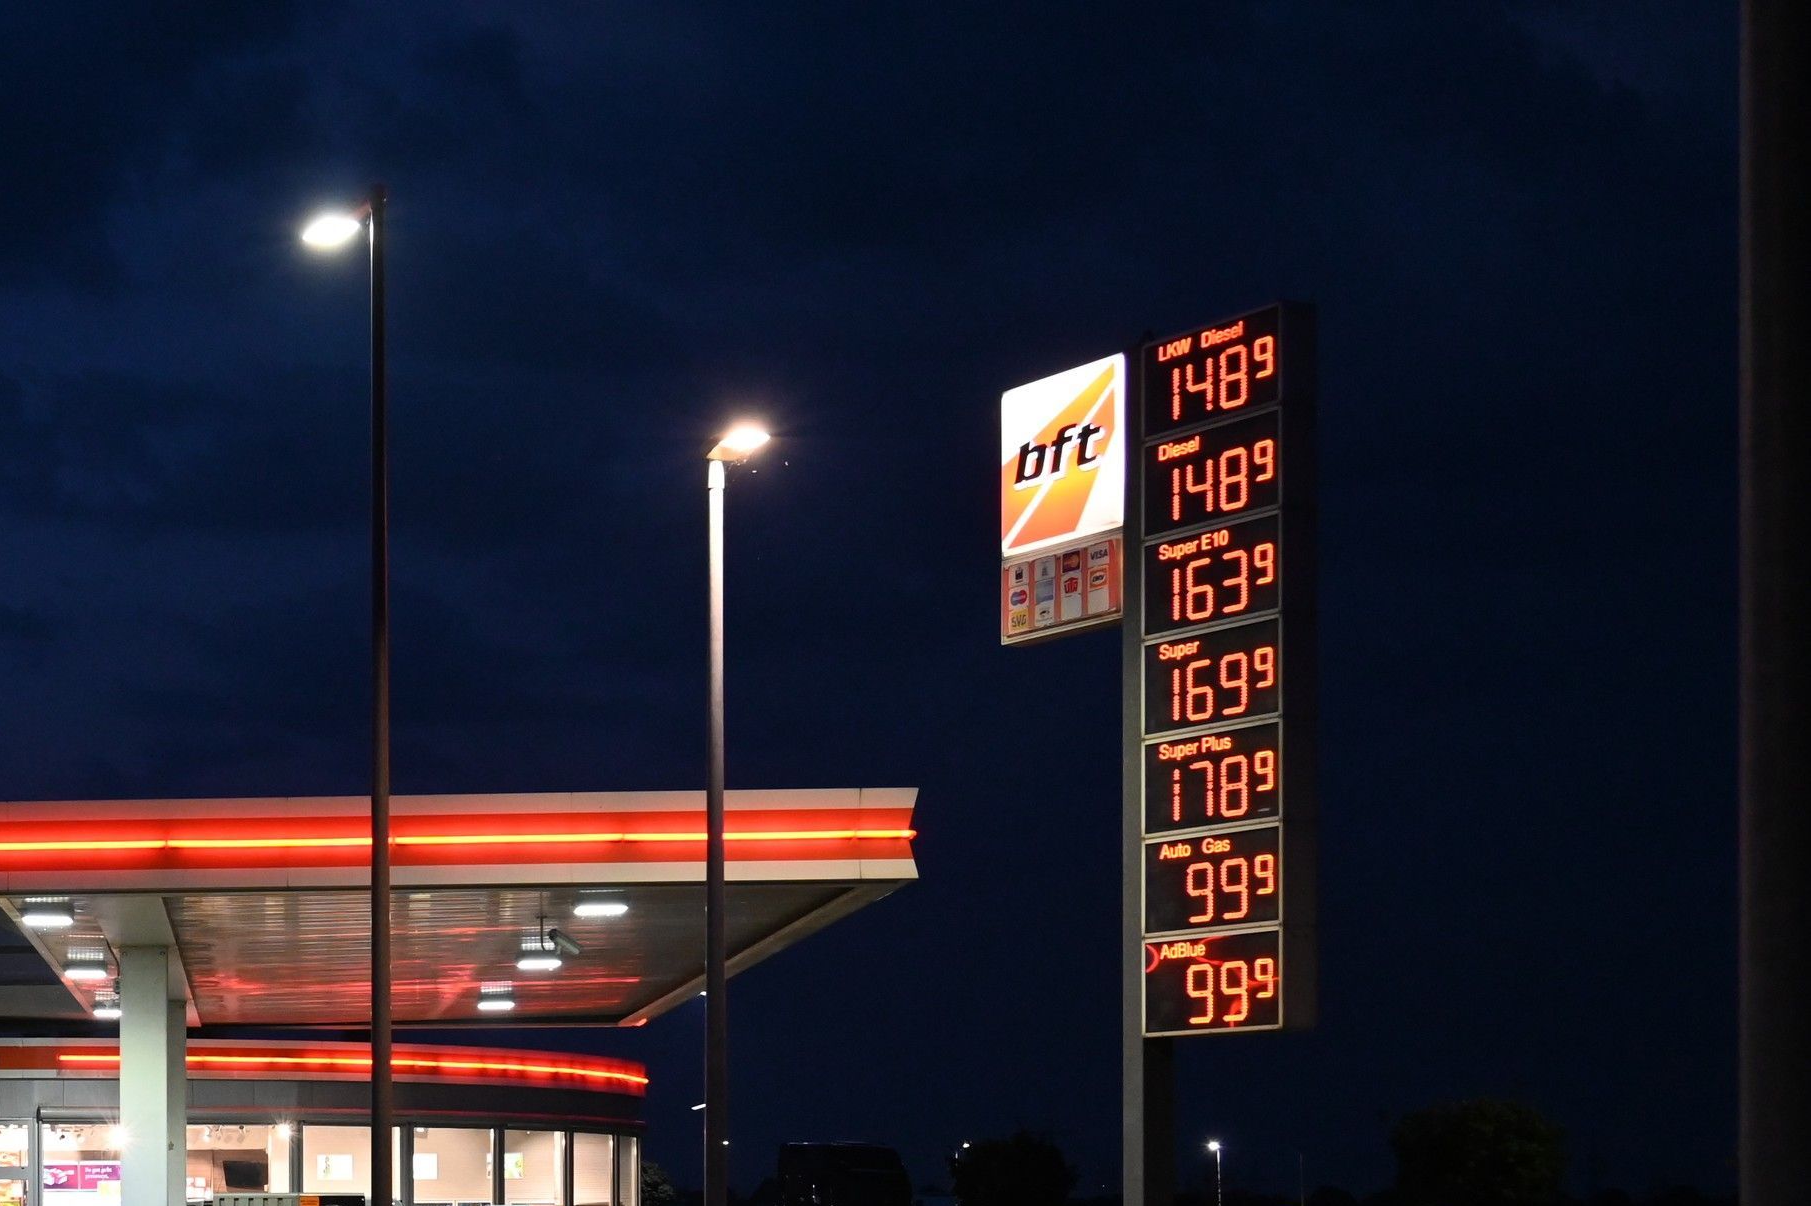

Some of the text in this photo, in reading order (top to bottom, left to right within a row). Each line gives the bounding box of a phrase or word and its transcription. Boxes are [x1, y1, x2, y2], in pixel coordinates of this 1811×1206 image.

[1158, 321, 1244, 362] LKW Diesel
[1014, 422, 1104, 487] bft
[1158, 435, 1201, 462] Diesel
[1090, 549, 1108, 561] VISA
[1158, 529, 1229, 562] Super E10
[1158, 639, 1200, 662] Super
[1159, 736, 1232, 761] Super Plus
[1159, 838, 1231, 860] Auto Gas
[1160, 941, 1206, 960] AdBlue
